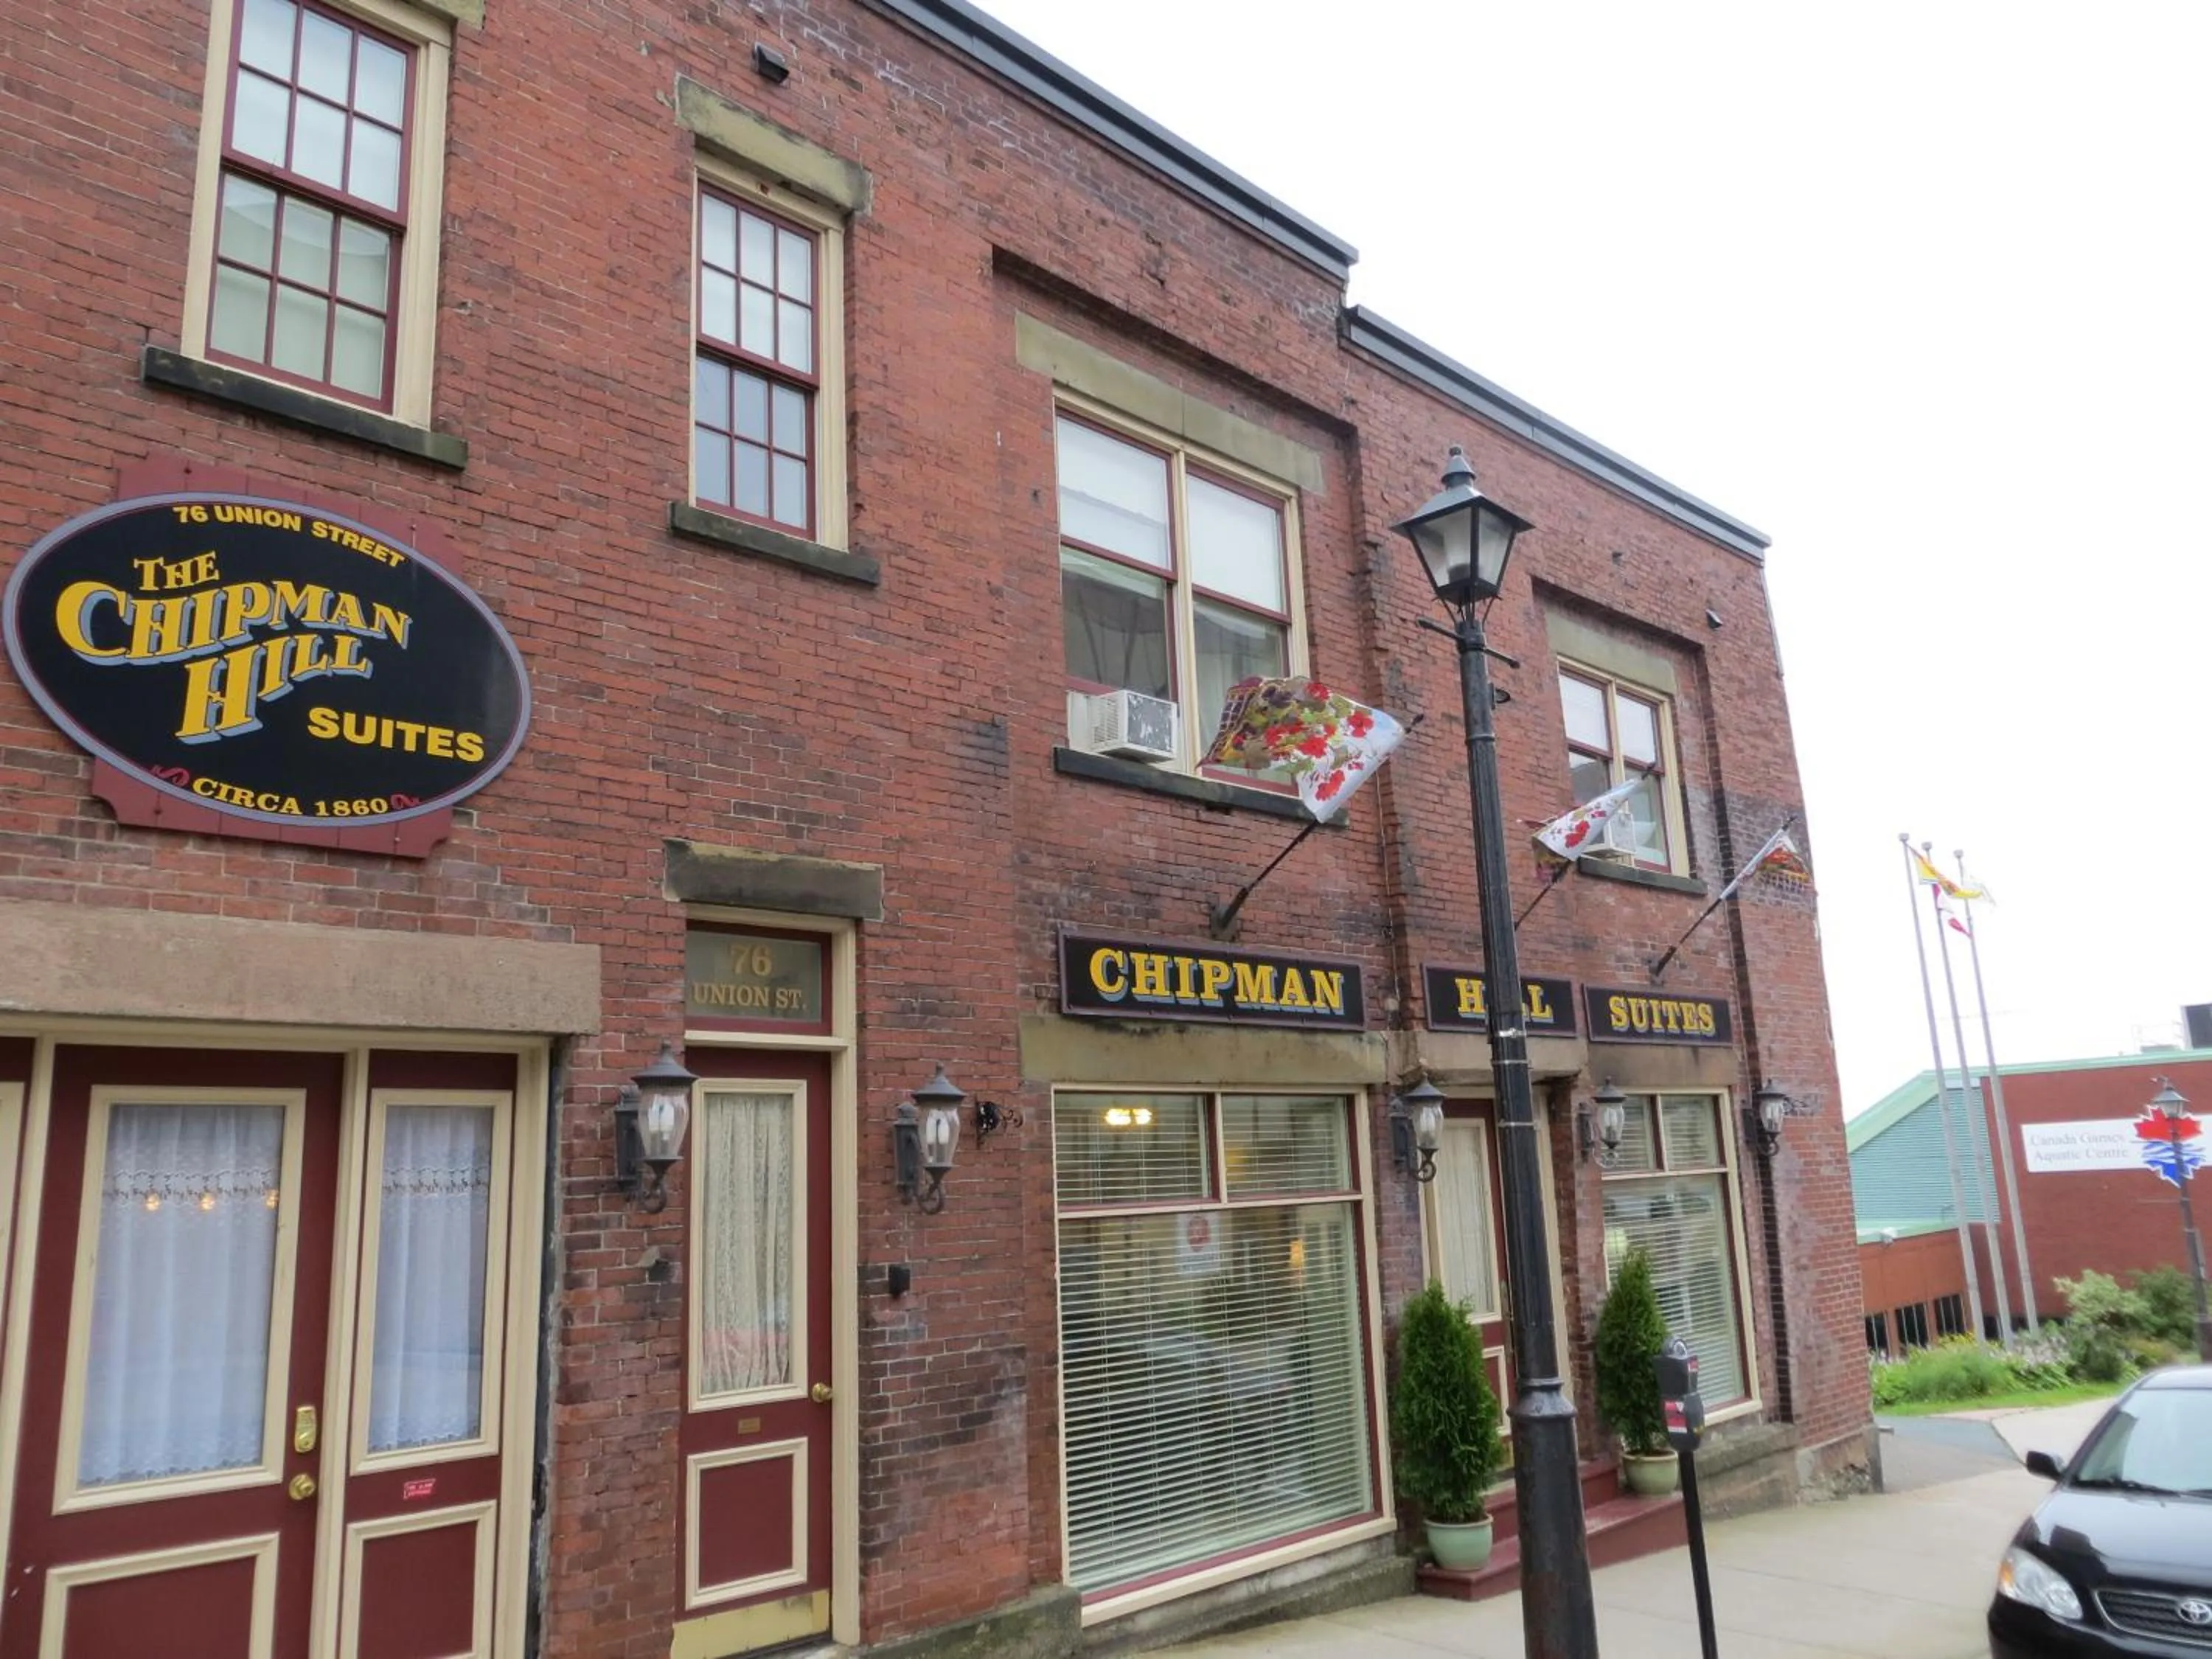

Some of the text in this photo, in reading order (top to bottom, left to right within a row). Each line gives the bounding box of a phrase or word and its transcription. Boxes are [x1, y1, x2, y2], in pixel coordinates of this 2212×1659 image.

[173, 504, 406, 568] 76 UNION STREET
[133, 550, 220, 592] THE
[55, 579, 413, 666] CHIPMAN
[175, 634, 373, 745] HILL
[307, 706, 486, 763] SUITES
[192, 776, 389, 818] CIRCA 1860
[730, 943, 773, 977] 76
[1089, 947, 1345, 1015] CHIPMAN
[693, 982, 808, 1010] UNION ST.
[1454, 977, 1554, 1023] HL
[1609, 995, 1717, 1036] SUITES
[2031, 1131, 2076, 1147] Canada
[2034, 1147, 2129, 1163] Aquatic Centre
